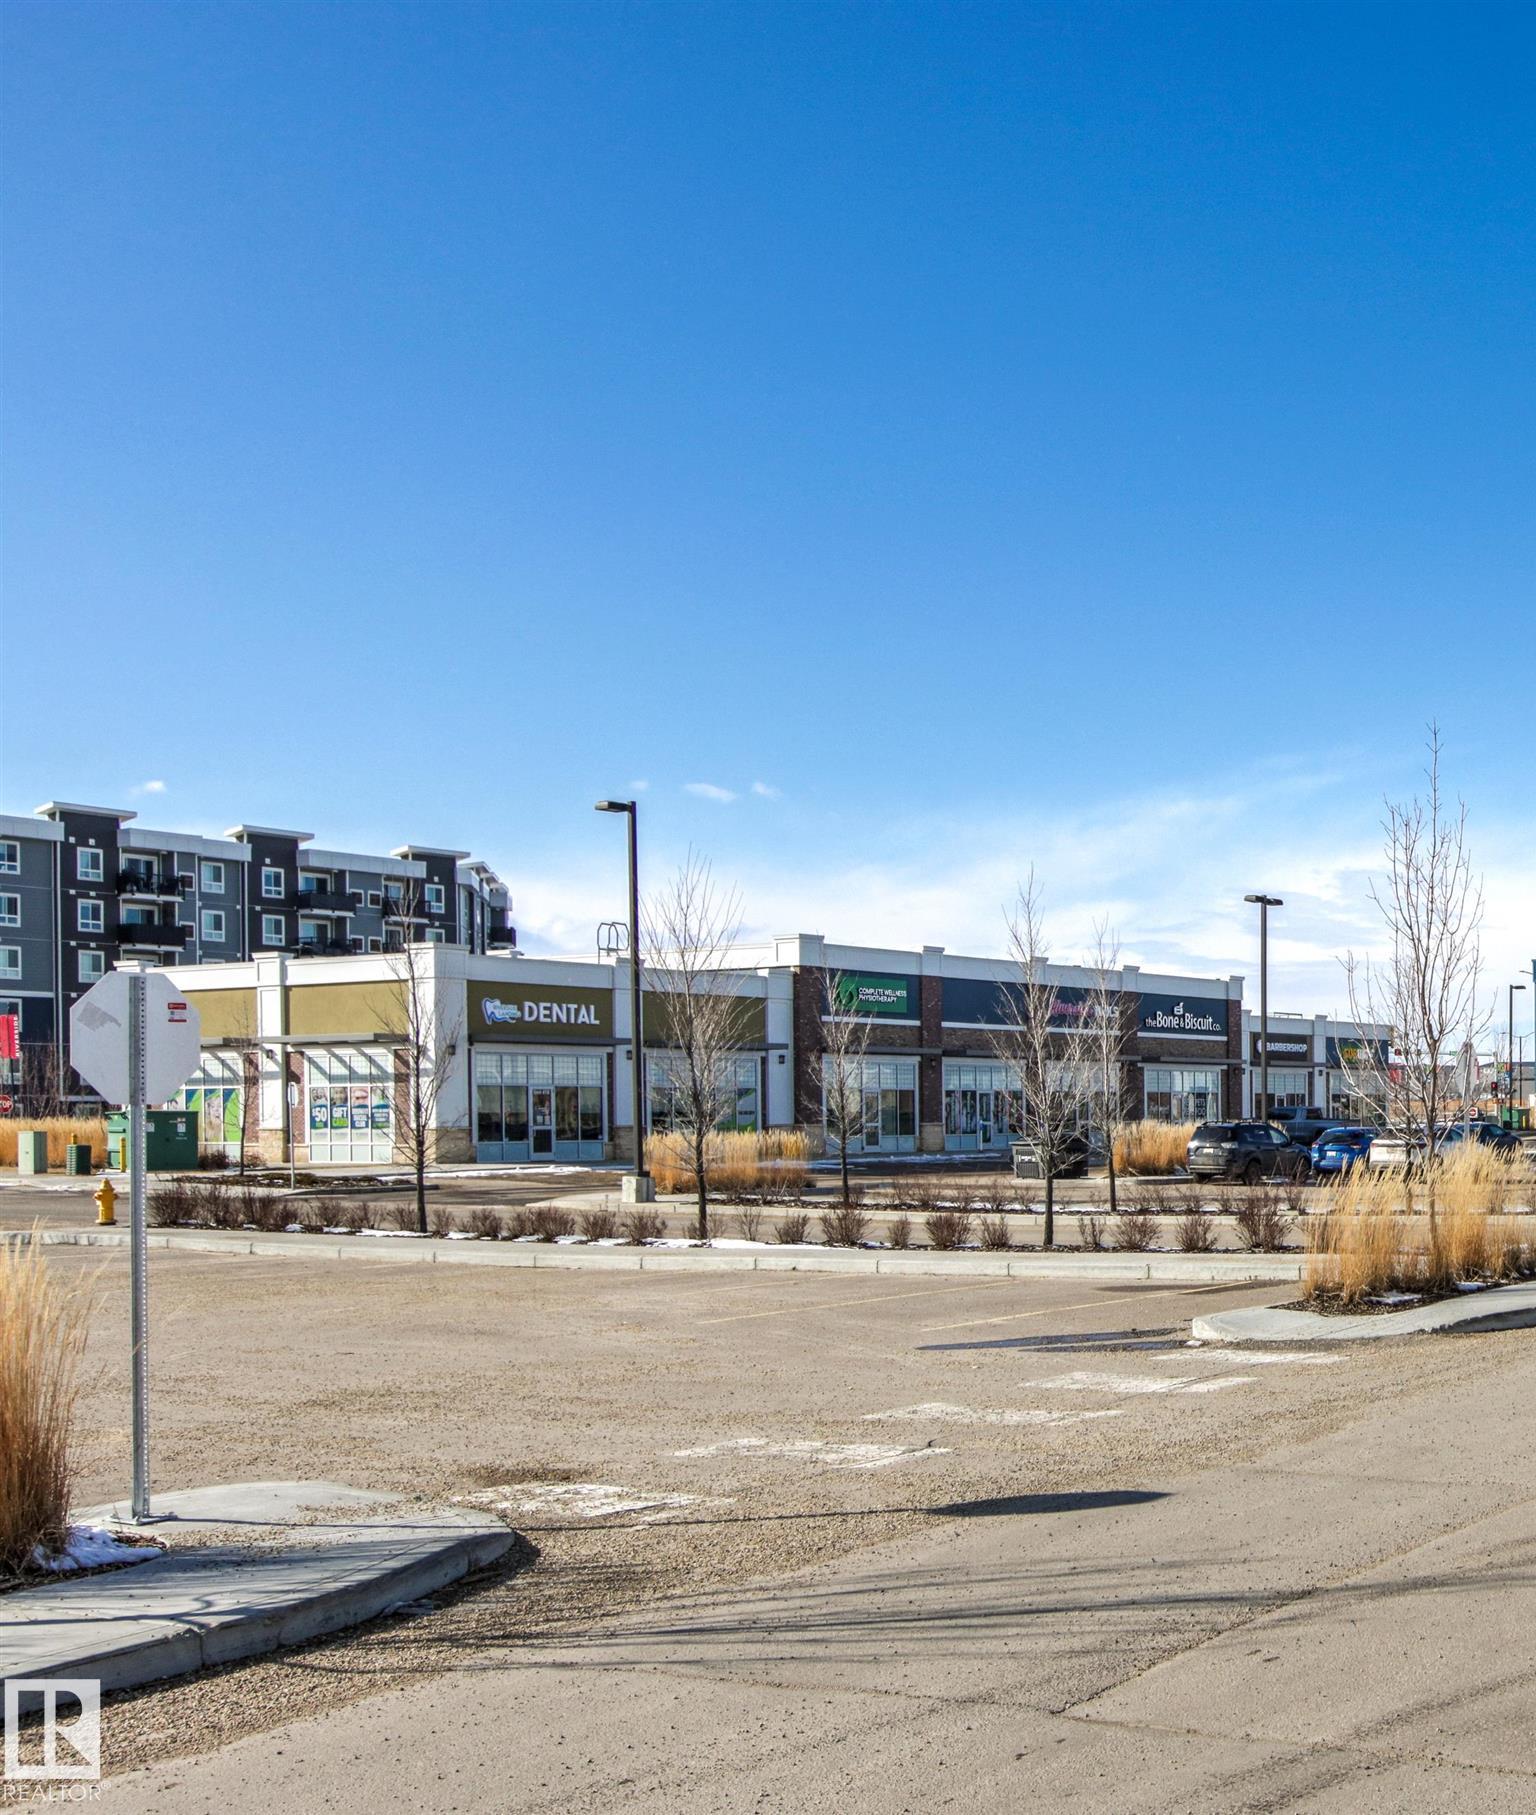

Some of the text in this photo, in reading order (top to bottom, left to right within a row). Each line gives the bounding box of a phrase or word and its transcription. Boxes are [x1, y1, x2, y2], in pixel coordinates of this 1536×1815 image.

[858, 987, 883, 996] COMPLETE
[858, 995, 897, 1003] PHYSIOTHERAPY
[523, 1001, 600, 1025] DENTAL
[1145, 1017, 1157, 1028] the
[1156, 1011, 1180, 1029] Bone
[1180, 1018, 1185, 1028] &
[1184, 1013, 1213, 1031] Biscuit
